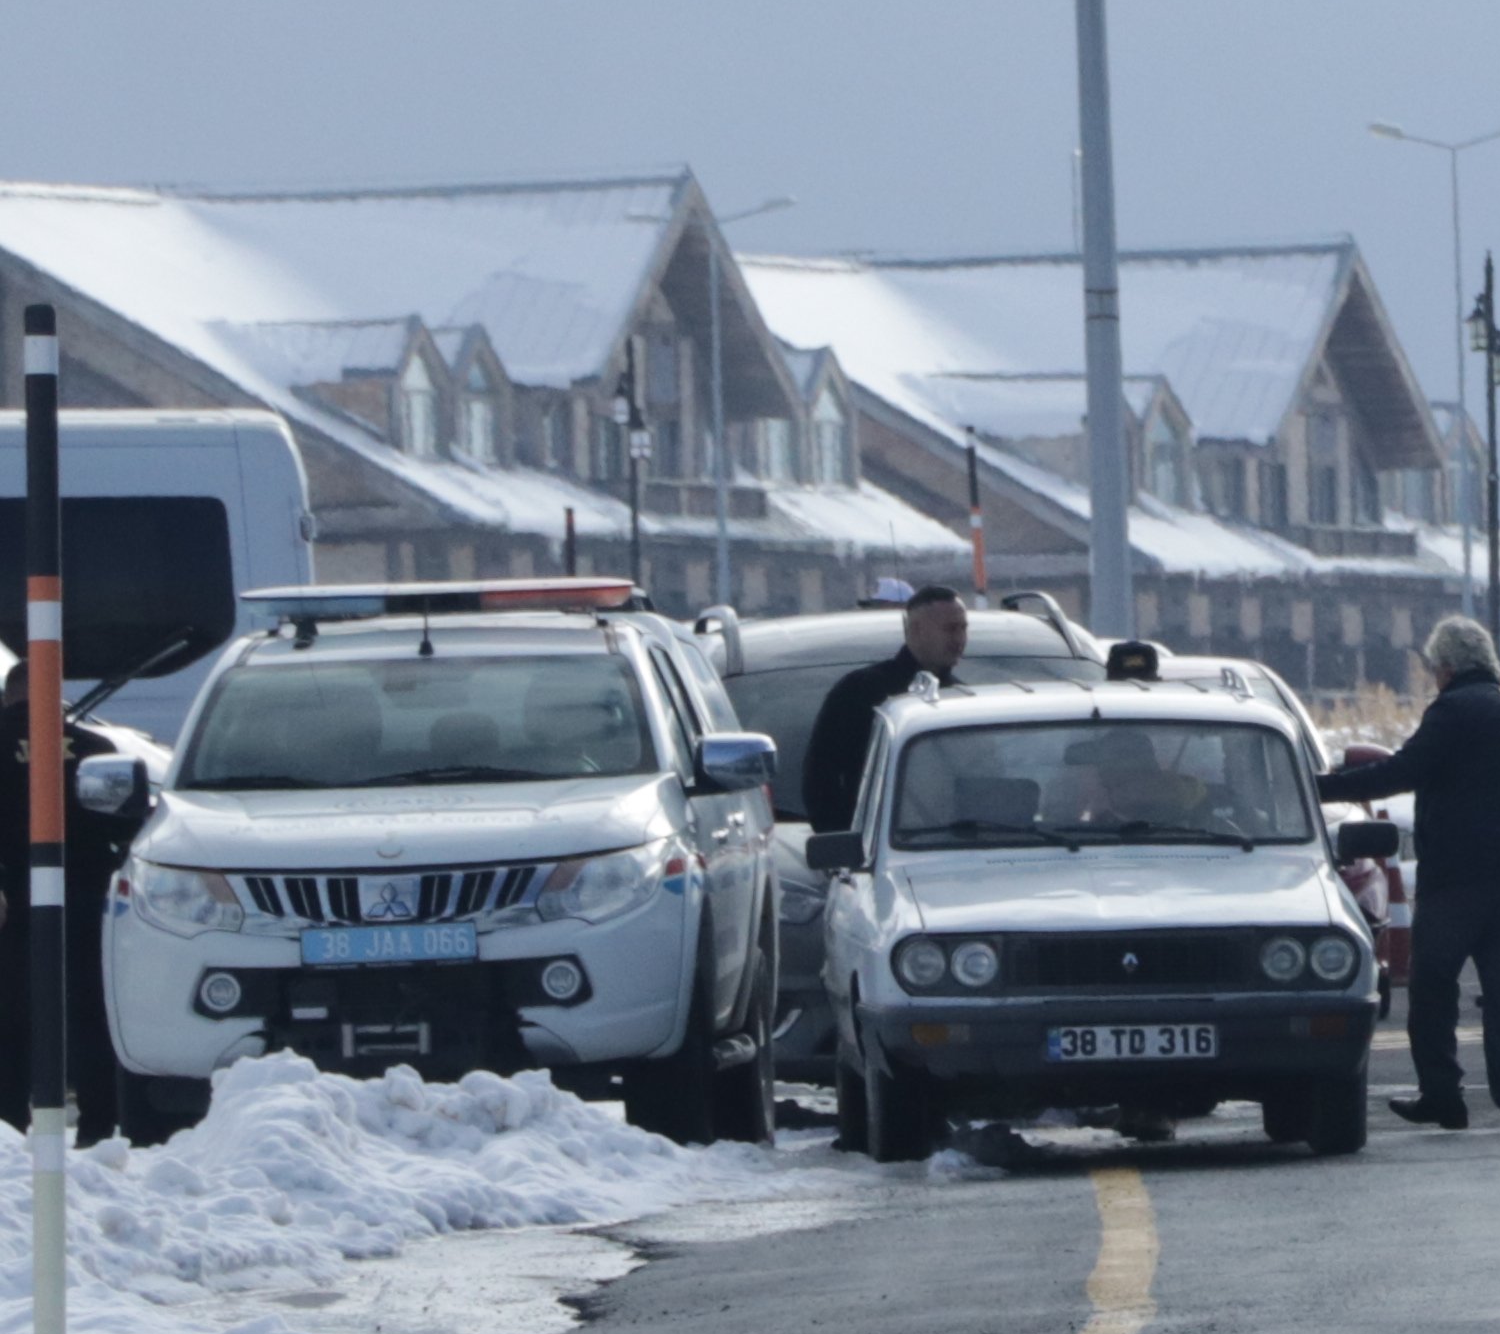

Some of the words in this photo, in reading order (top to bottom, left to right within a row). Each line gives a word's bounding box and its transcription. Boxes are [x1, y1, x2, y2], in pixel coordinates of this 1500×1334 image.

[321, 931, 350, 959] 38
[365, 930, 413, 957] JAA
[423, 928, 470, 955] 066
[1061, 1029, 1097, 1057] 38
[1110, 1028, 1146, 1055] TD
[1158, 1027, 1212, 1055] 316
